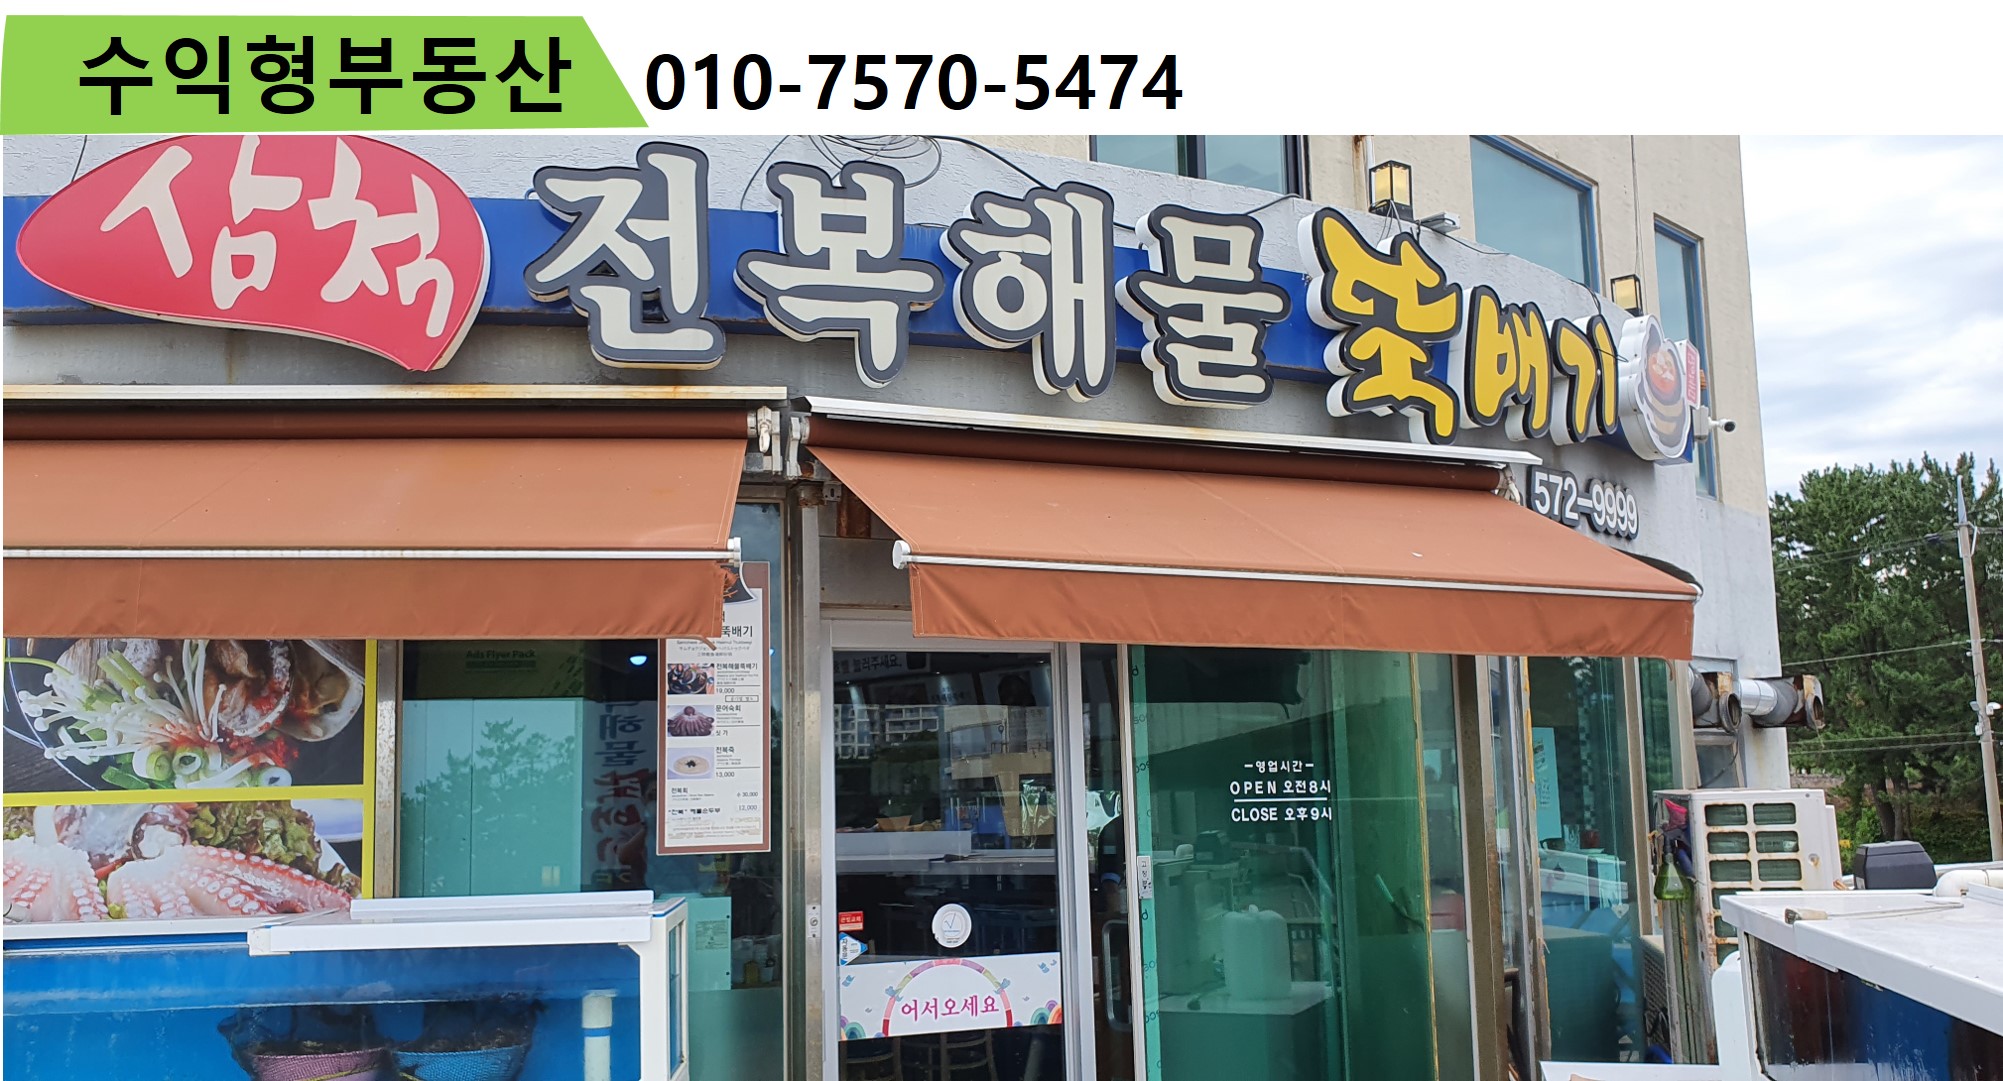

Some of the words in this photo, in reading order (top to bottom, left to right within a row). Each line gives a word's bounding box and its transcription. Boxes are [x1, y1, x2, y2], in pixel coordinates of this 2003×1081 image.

[100, 135, 455, 338] 삼척
[1534, 470, 1638, 535] 572-9999
[512, 648, 536, 658] Pack
[1230, 780, 1277, 795] OPEN
[1283, 779, 1331, 794] 오전8시
[1231, 807, 1278, 822] CLOSE
[1284, 806, 1332, 821] 오후9시
[900, 994, 1000, 1022] 어서오세요
